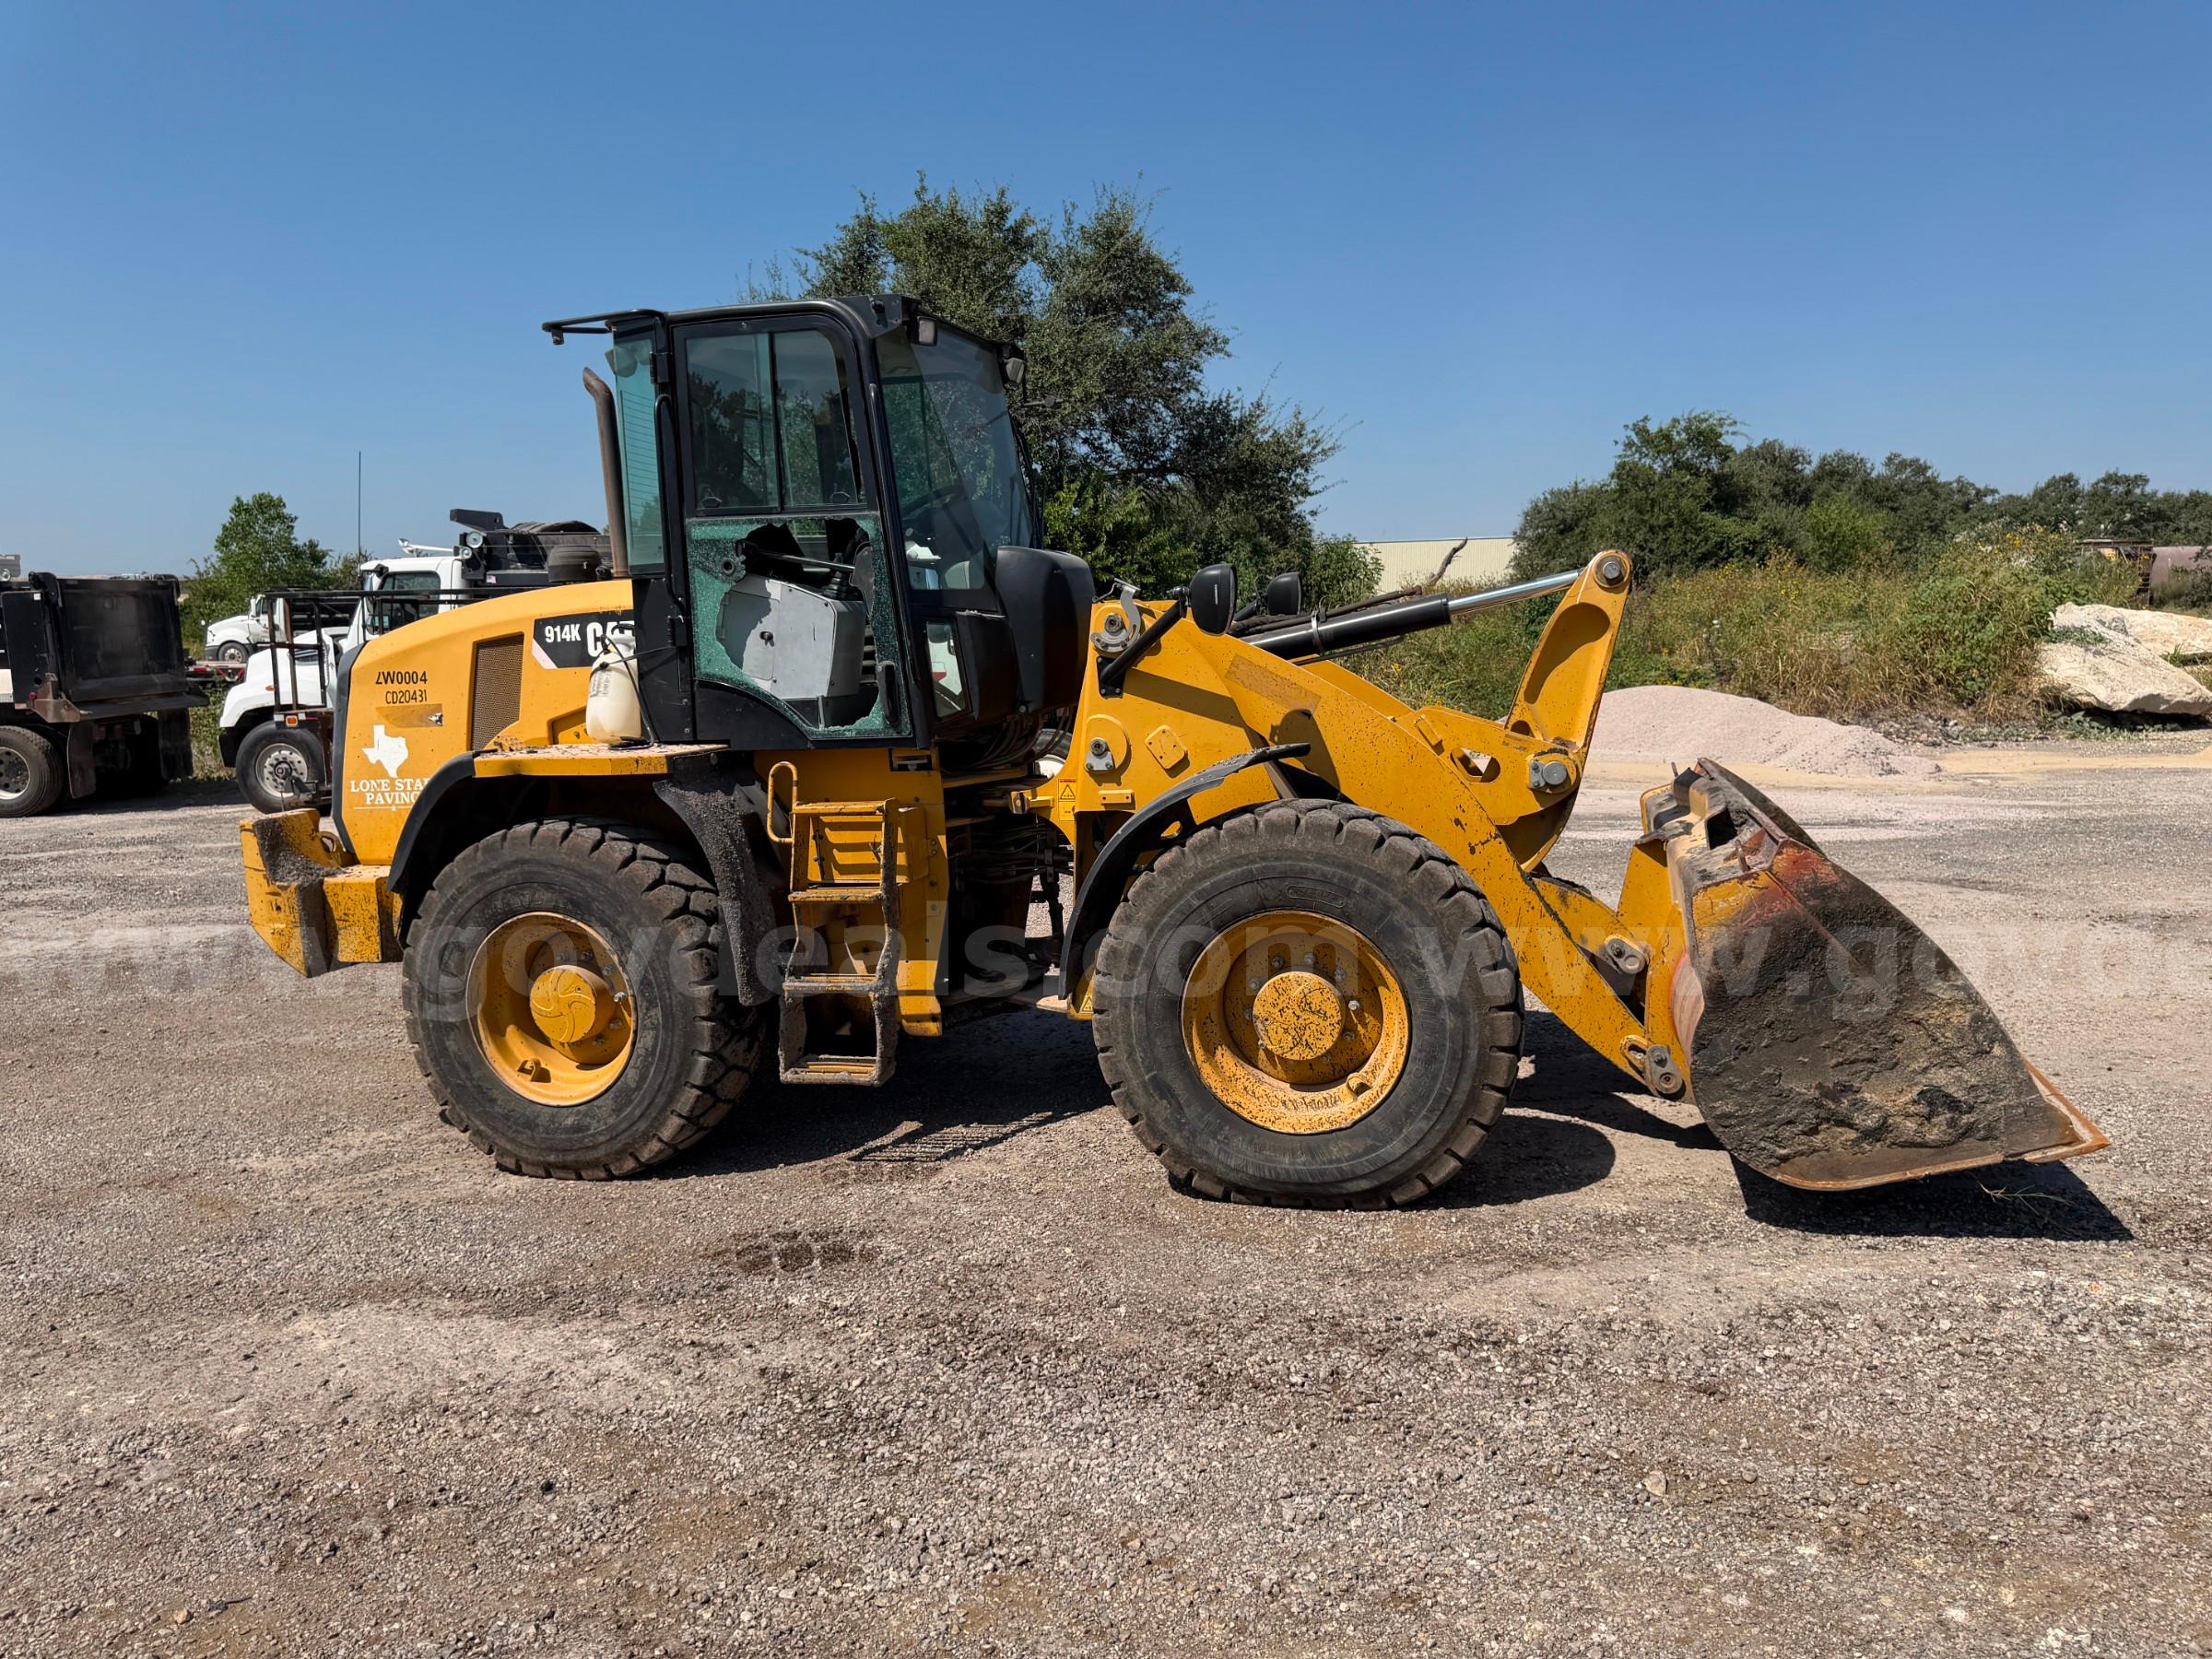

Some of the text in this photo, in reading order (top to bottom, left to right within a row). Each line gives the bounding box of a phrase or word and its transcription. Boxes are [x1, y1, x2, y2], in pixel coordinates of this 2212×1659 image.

[545, 620, 635, 657] 914K CA
[385, 689, 427, 704] CD20431
[350, 780, 390, 793] LONE
